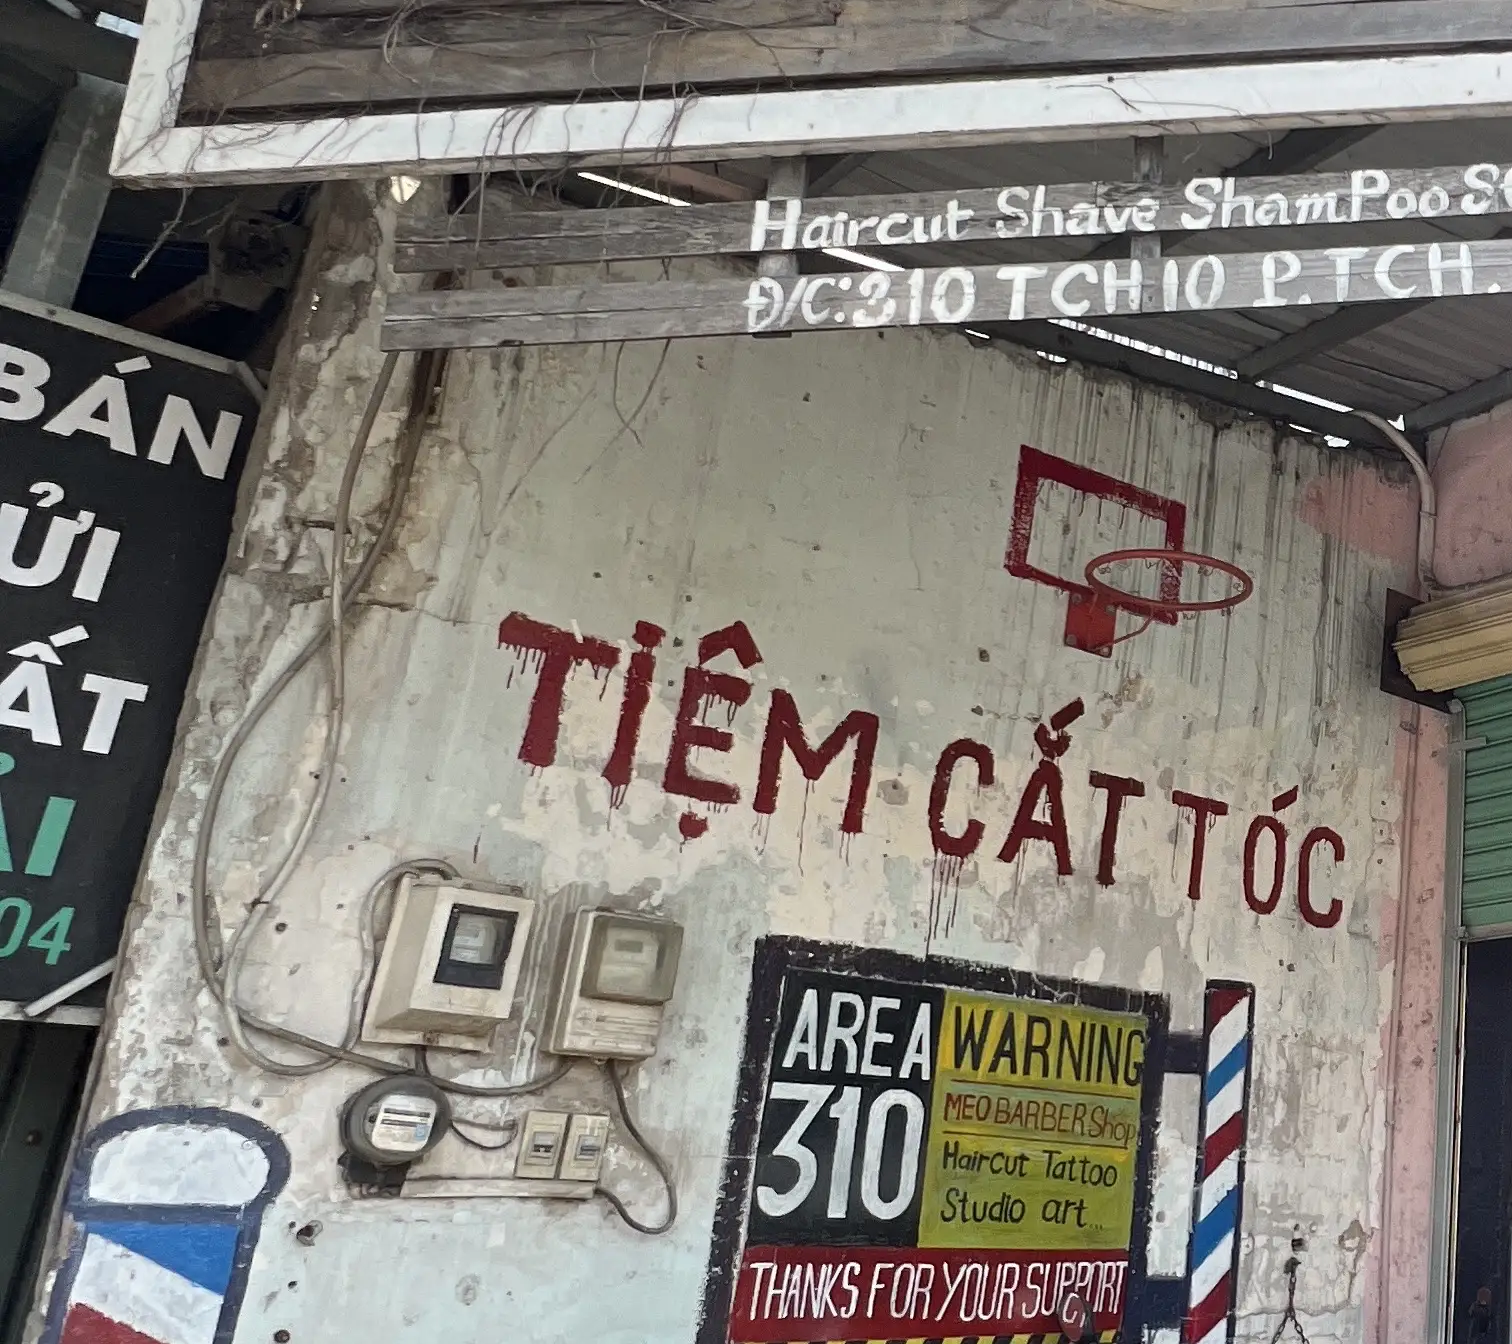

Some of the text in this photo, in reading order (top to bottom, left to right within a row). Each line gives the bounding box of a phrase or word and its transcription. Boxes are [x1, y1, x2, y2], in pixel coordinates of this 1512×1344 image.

[750, 197, 975, 251] Haircut
[996, 185, 1160, 237] Shave
[0, 343, 243, 481] BÁN
[926, 696, 1145, 888] CẮT
[1172, 784, 1345, 929] TÓC
[782, 988, 1146, 1086] AREA WARNING
[755, 1081, 927, 1221] 310
[943, 1092, 1137, 1147] MEO BARBER Shop
[1042, 1149, 1118, 1187] Tattoo
[940, 1187, 1025, 1224] Studio
[750, 1261, 860, 1321] THANKS
[867, 1261, 935, 1320] FOR
[934, 1261, 1020, 1323] YOUR
